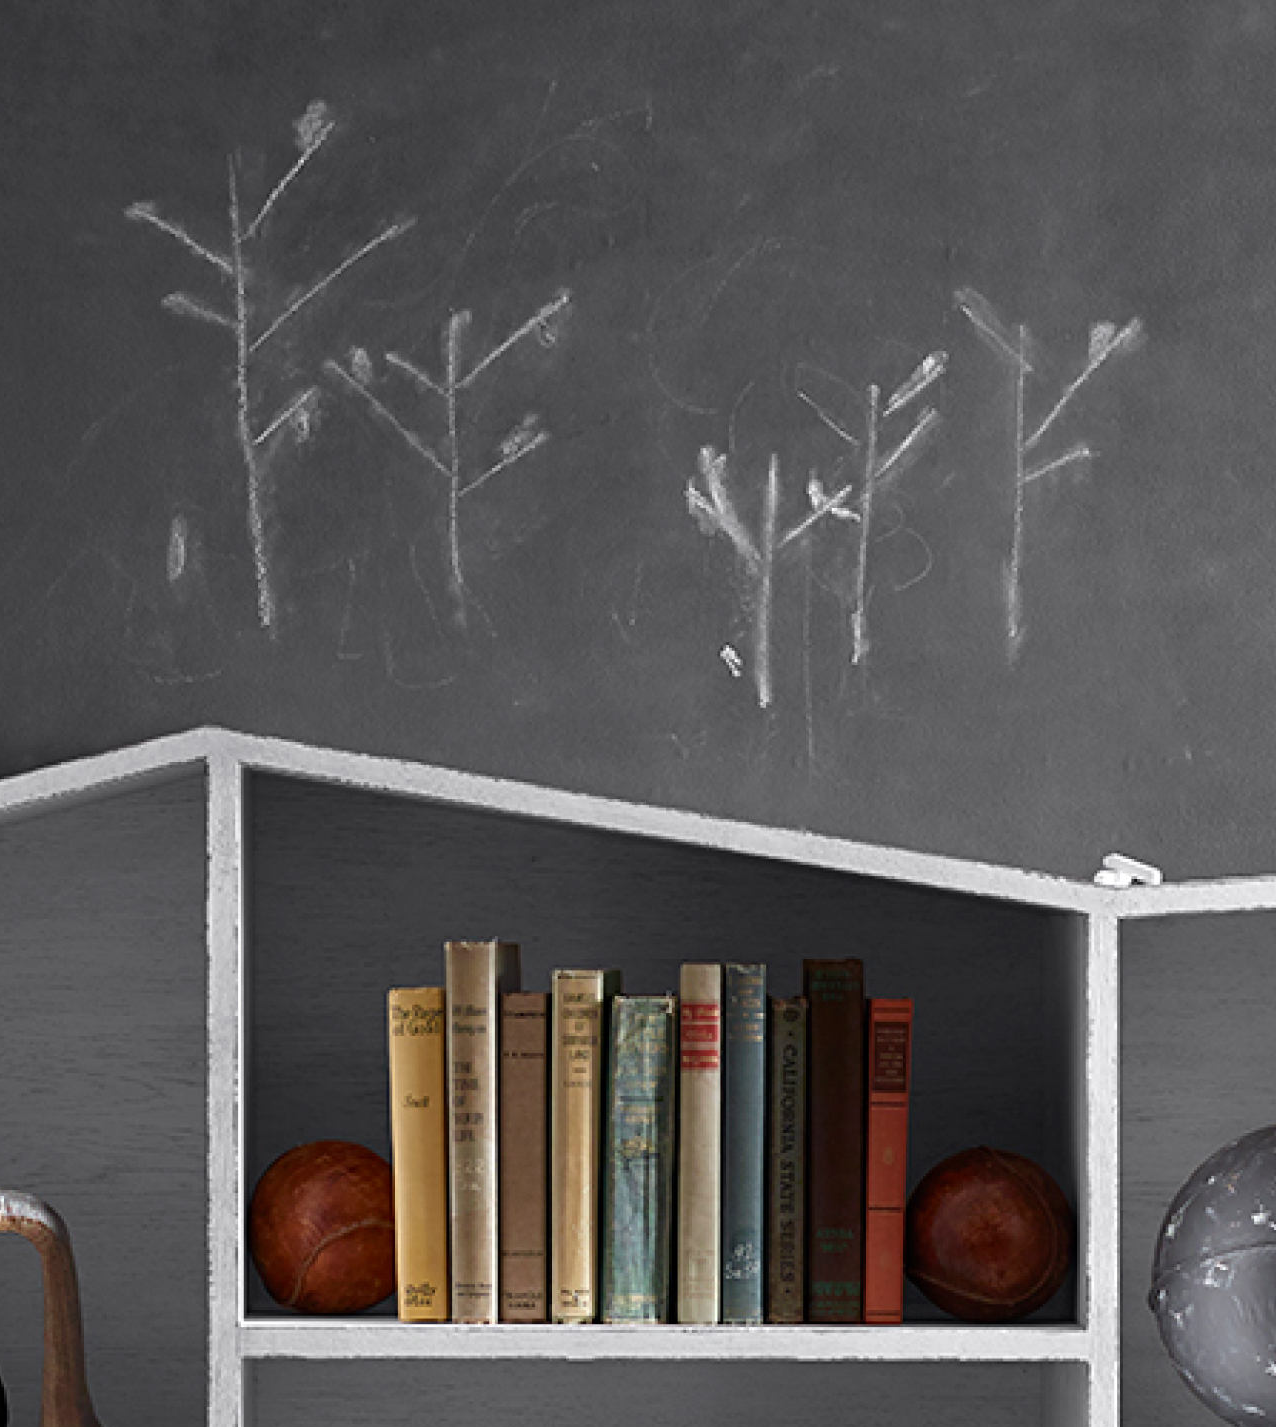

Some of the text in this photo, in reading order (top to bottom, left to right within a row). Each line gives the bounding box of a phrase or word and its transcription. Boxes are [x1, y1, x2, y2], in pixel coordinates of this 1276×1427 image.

[779, 1043, 799, 1283] CALIFORNIA STATE SERIES
